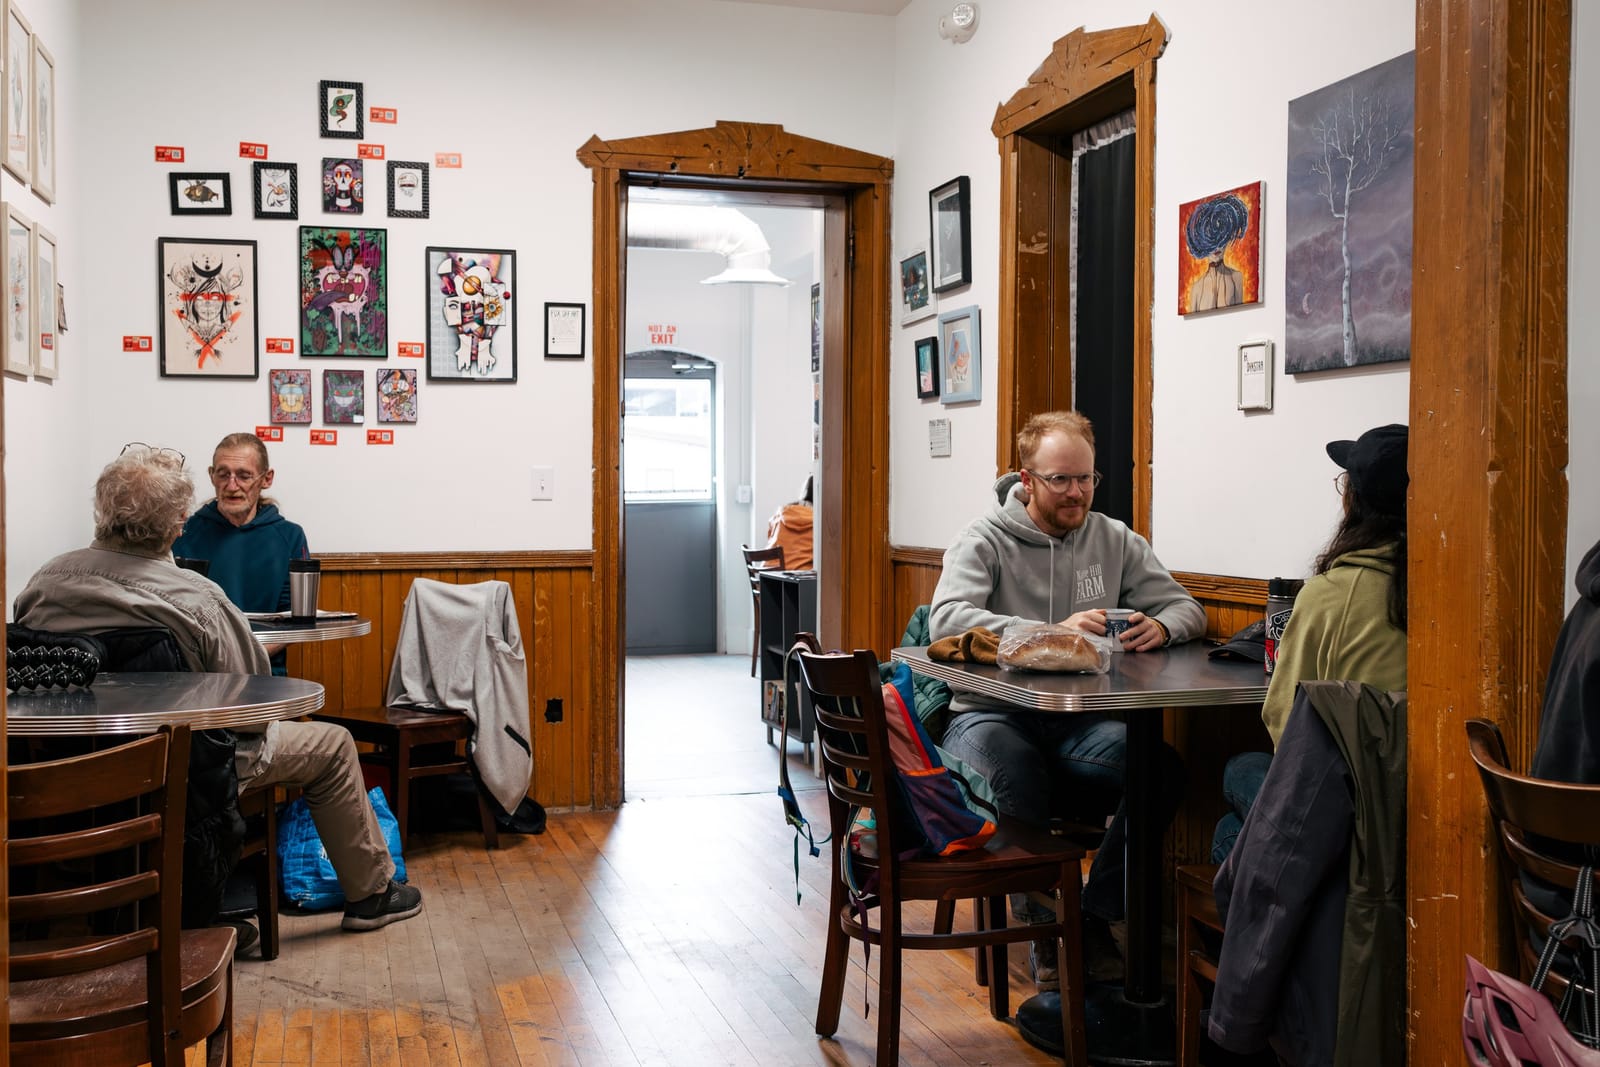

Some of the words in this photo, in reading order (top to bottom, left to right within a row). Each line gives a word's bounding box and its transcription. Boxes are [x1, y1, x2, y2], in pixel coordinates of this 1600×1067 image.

[648, 325, 662, 333] NOT
[667, 325, 677, 333] AN
[651, 334, 674, 345] EXIT
[1076, 575, 1105, 600] FARM
